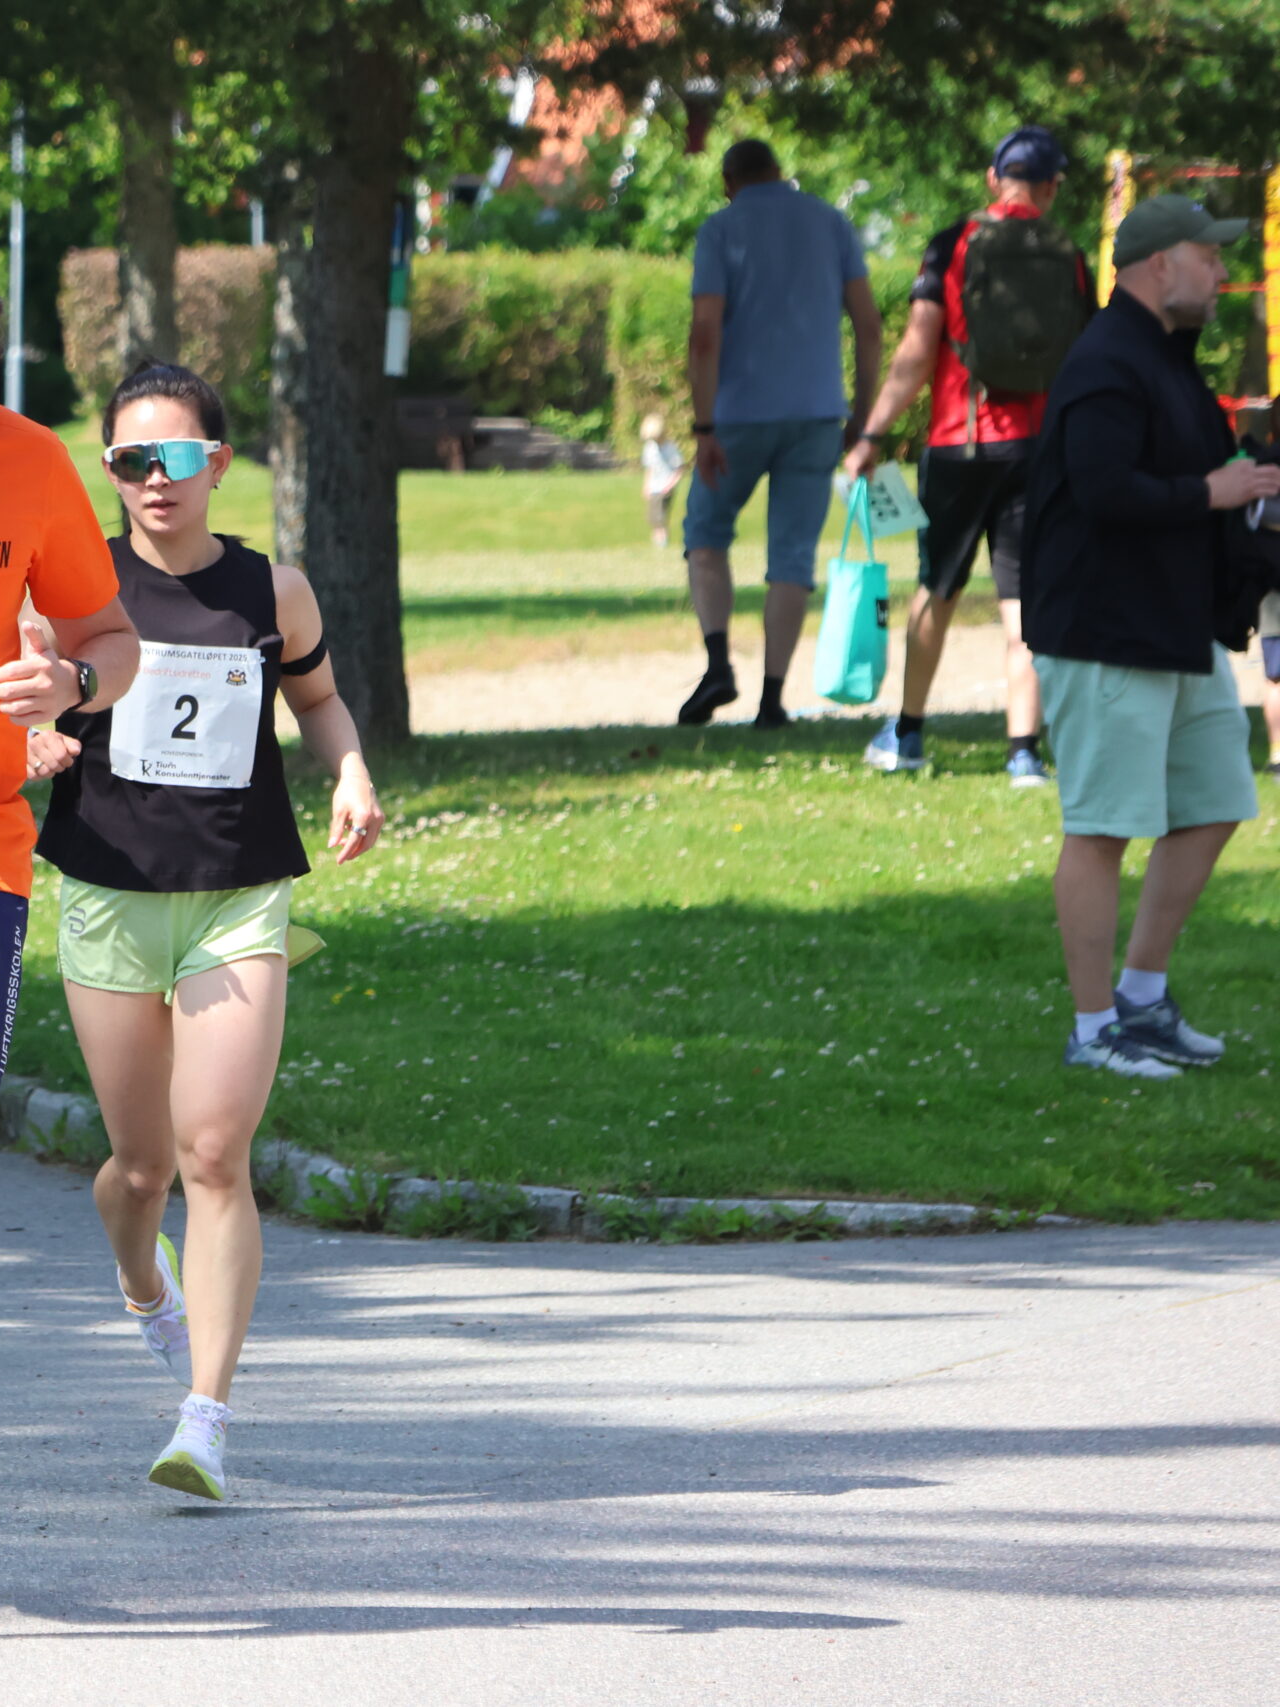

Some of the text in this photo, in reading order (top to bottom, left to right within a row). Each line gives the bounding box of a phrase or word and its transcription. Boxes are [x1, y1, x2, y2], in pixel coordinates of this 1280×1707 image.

[143, 648, 247, 662] NTRUMSGATELØPET 2025
[171, 694, 199, 740] 2
[155, 770, 231, 780] Konsulenttjenester
